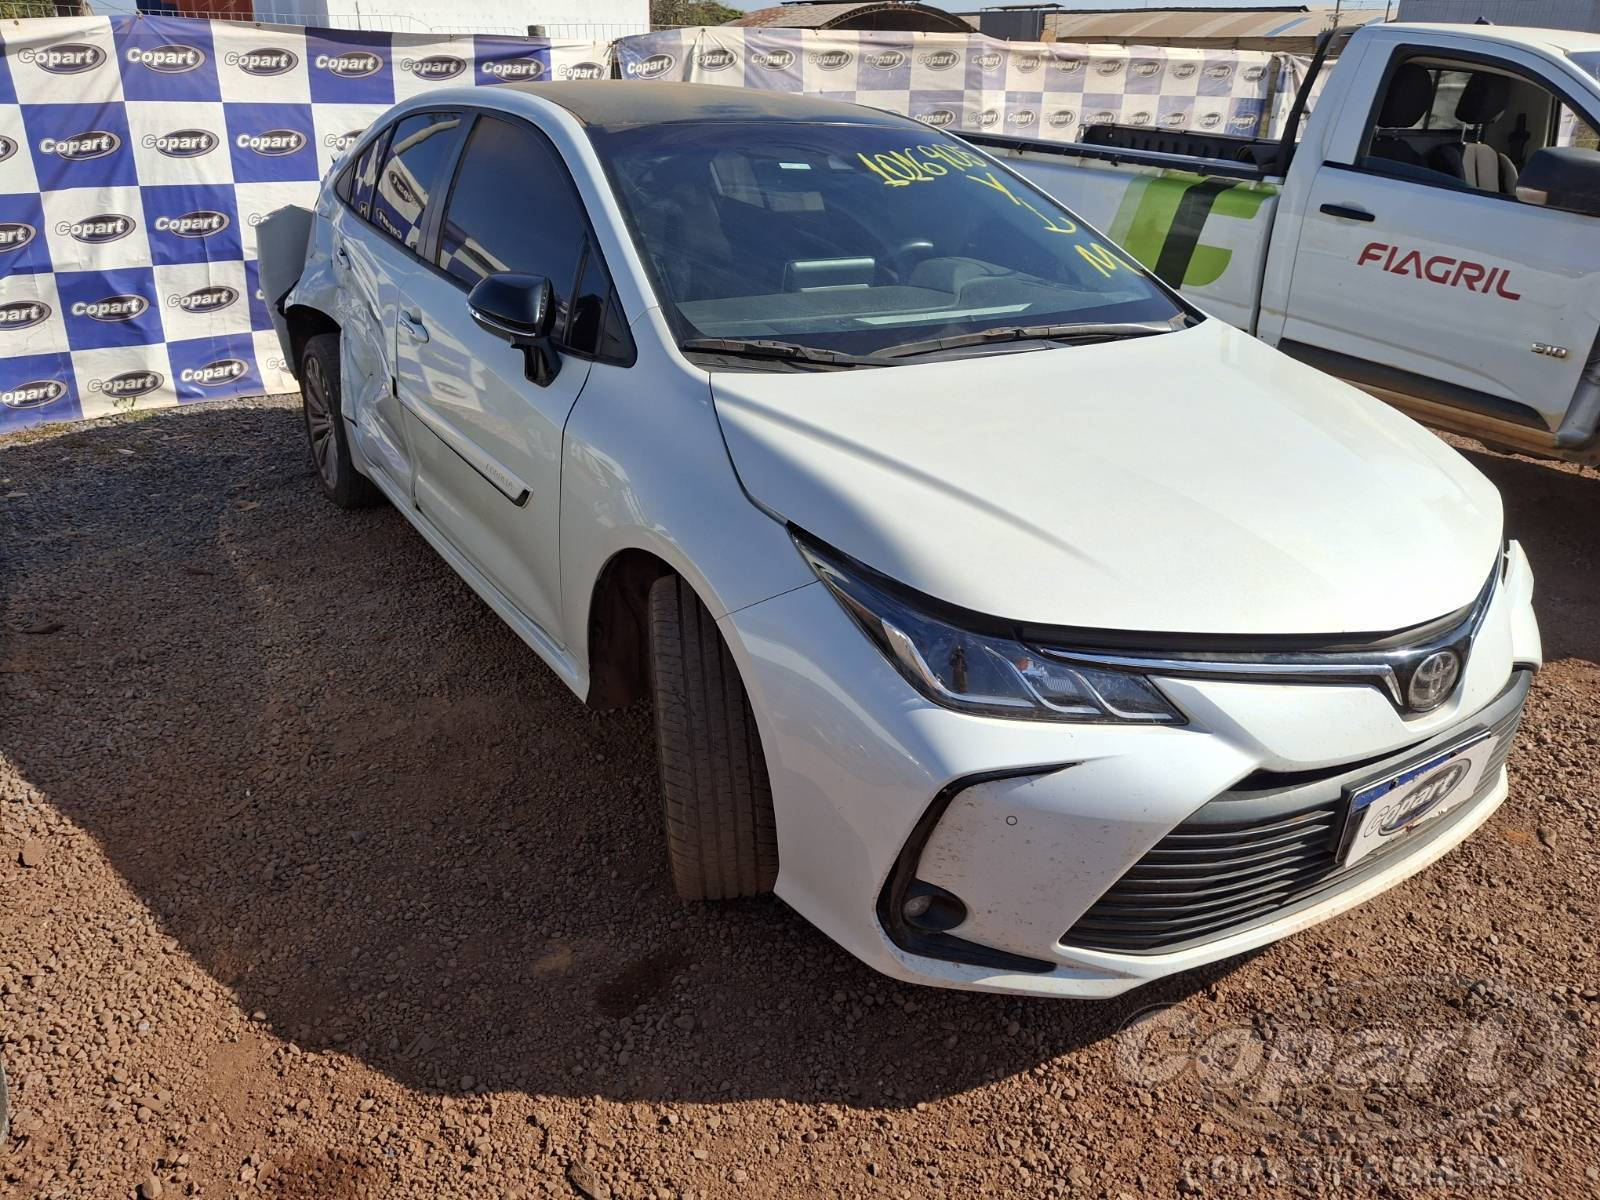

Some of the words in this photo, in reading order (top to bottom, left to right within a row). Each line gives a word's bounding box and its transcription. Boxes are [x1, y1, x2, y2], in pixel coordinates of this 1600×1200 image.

[18, 48, 95, 68] Copart
[127, 48, 194, 67] Copart
[225, 52, 288, 70] Copart
[315, 55, 376, 71] Copart
[401, 57, 459, 73] Copart
[751, 53, 790, 65] Copart
[808, 53, 846, 66] Copart
[864, 54, 900, 67] Copart
[918, 54, 955, 67] Copart
[482, 61, 537, 77] Copart
[559, 64, 599, 80] Copart
[626, 58, 670, 75] Copart
[914, 113, 950, 124] Copart
[40, 135, 109, 154] Copart
[142, 134, 209, 153] Copart
[236, 133, 298, 151] Copart
[56, 220, 125, 237] Copart
[155, 217, 221, 235] Copart
[0, 229, 26, 243] art
[1357, 242, 1521, 301] FIAGRIL
[167, 288, 230, 309] Copart
[0, 306, 40, 323] part
[72, 301, 140, 321] Copart
[1531, 342, 1567, 358] S10
[181, 363, 241, 384] Copart
[88, 373, 156, 394] Copart
[0, 382, 56, 404] opart
[1364, 767, 1458, 838] Copart
